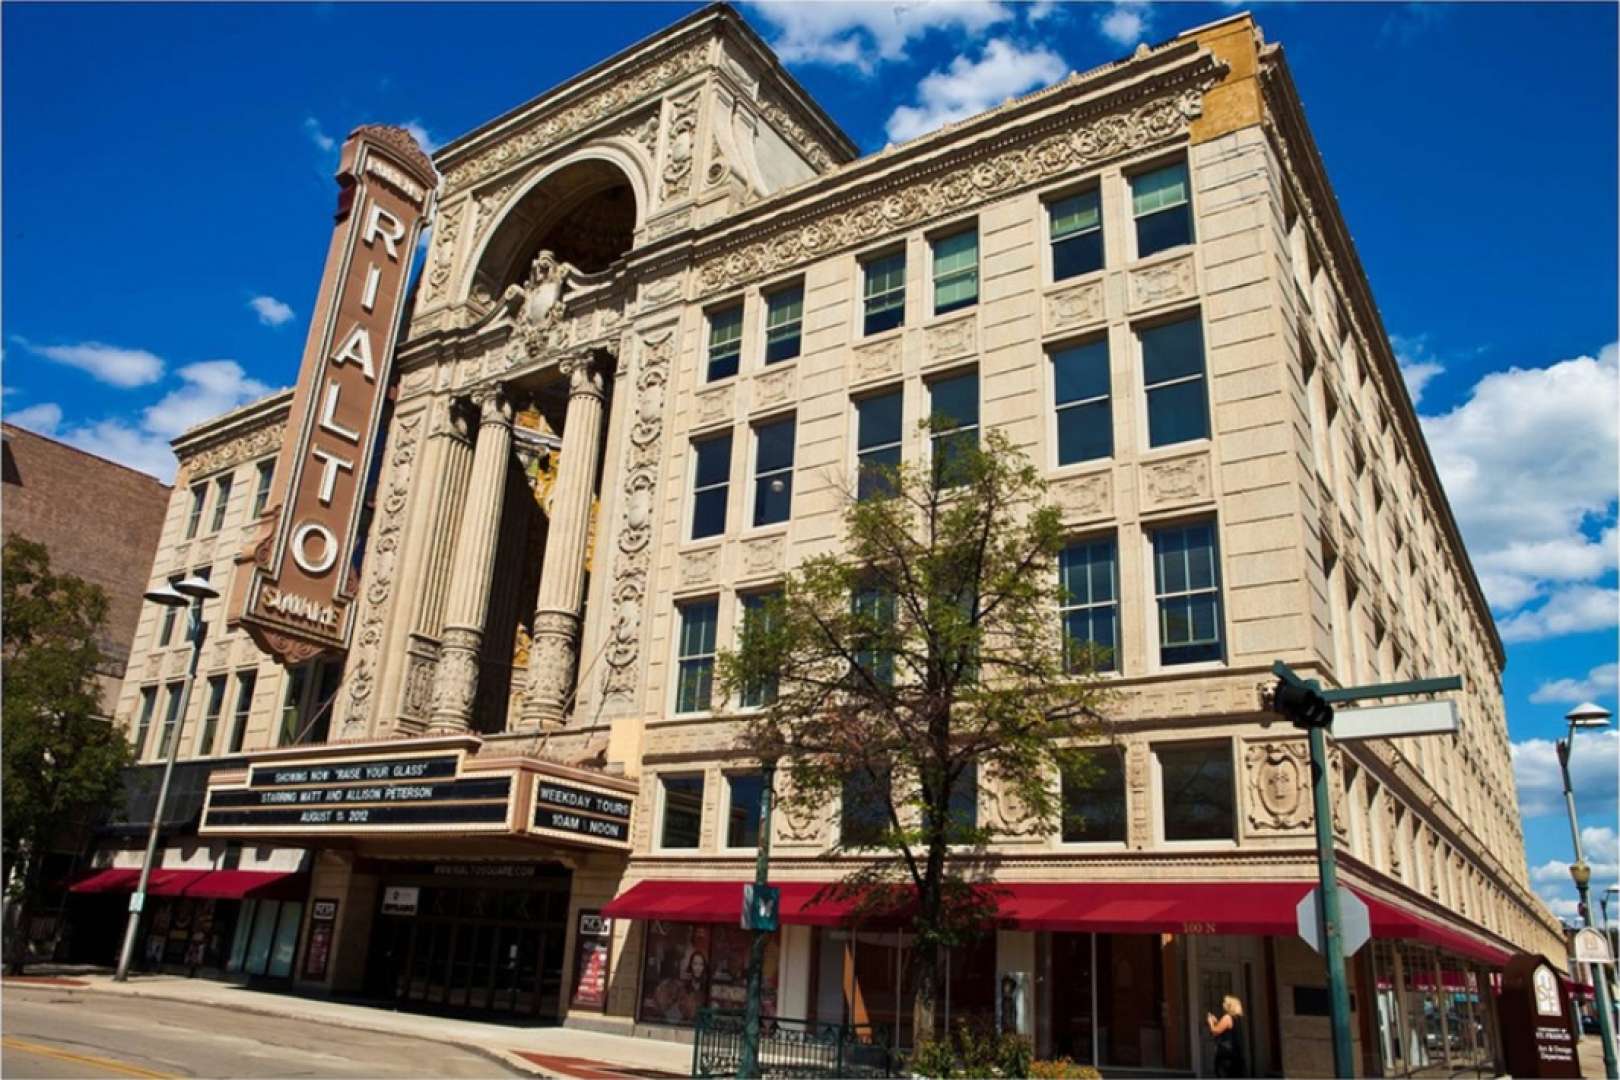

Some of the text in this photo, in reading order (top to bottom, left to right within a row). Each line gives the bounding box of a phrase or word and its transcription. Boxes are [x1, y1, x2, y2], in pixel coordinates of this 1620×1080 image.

[289, 198, 406, 574] RIALTO
[310, 769, 328, 781] NOW
[366, 765, 389, 778] YOUR
[261, 786, 433, 803] STARRING MATT AND ALLISON PETERSON
[541, 786, 629, 816] WEEKDAY TOURS
[300, 810, 333, 822] AUGUST
[348, 809, 369, 822] 2012
[552, 813, 579, 830] 10AM
[589, 821, 619, 837] NOON
